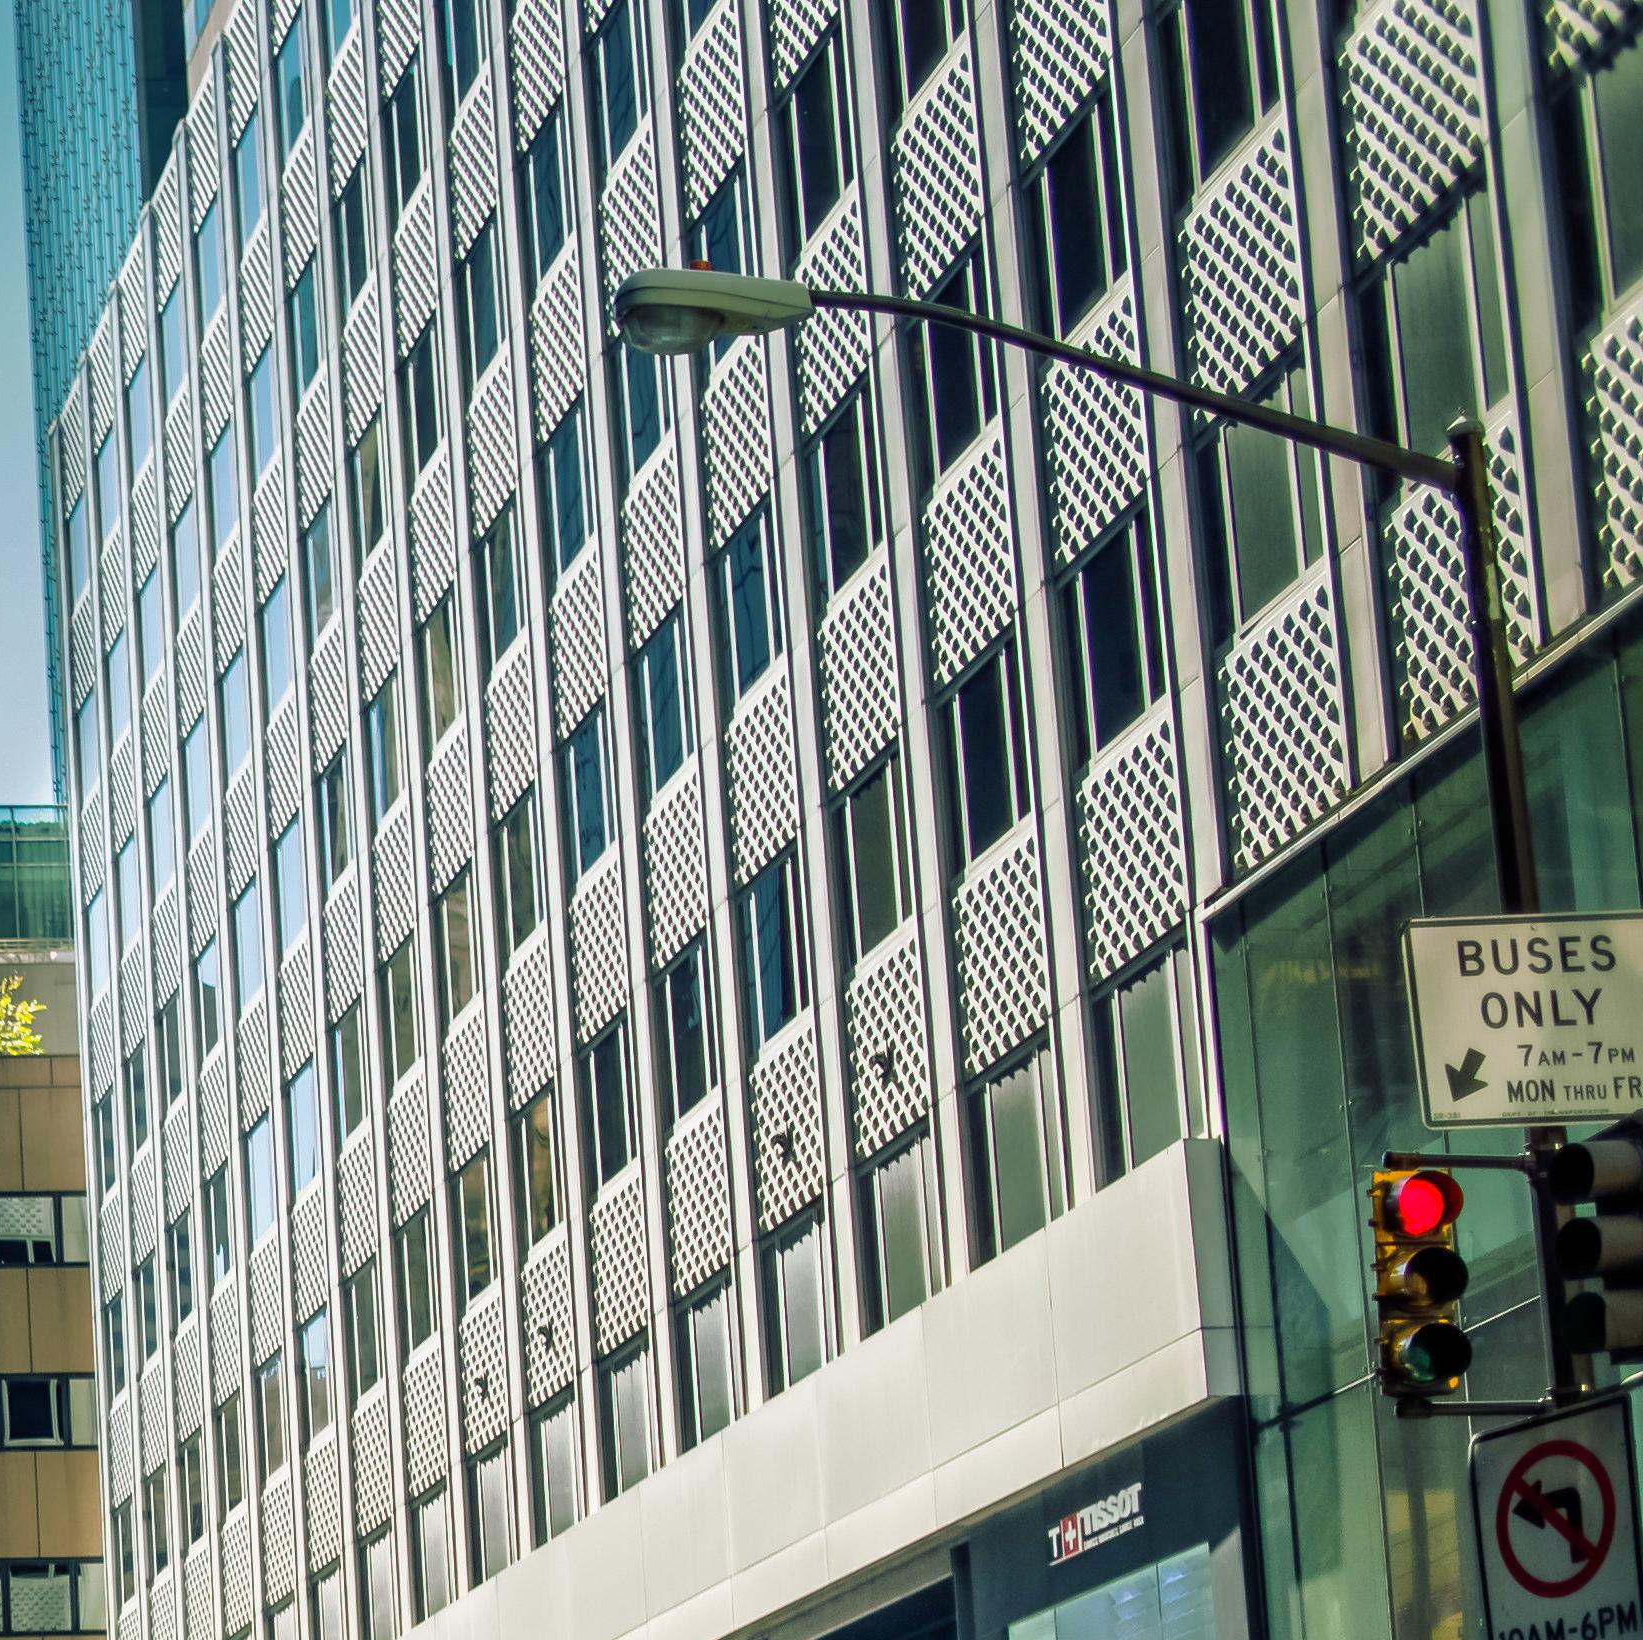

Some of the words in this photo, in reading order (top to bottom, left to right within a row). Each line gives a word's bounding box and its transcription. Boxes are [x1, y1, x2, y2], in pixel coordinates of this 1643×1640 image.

[1457, 935, 1616, 977] BUSES
[1481, 988, 1603, 1029] ONLY
[1507, 1079, 1556, 1103] MON
[1563, 1084, 1607, 1100] THRU
[1613, 1076, 1643, 1099] FR
[1079, 1482, 1142, 1536] TISSOT
